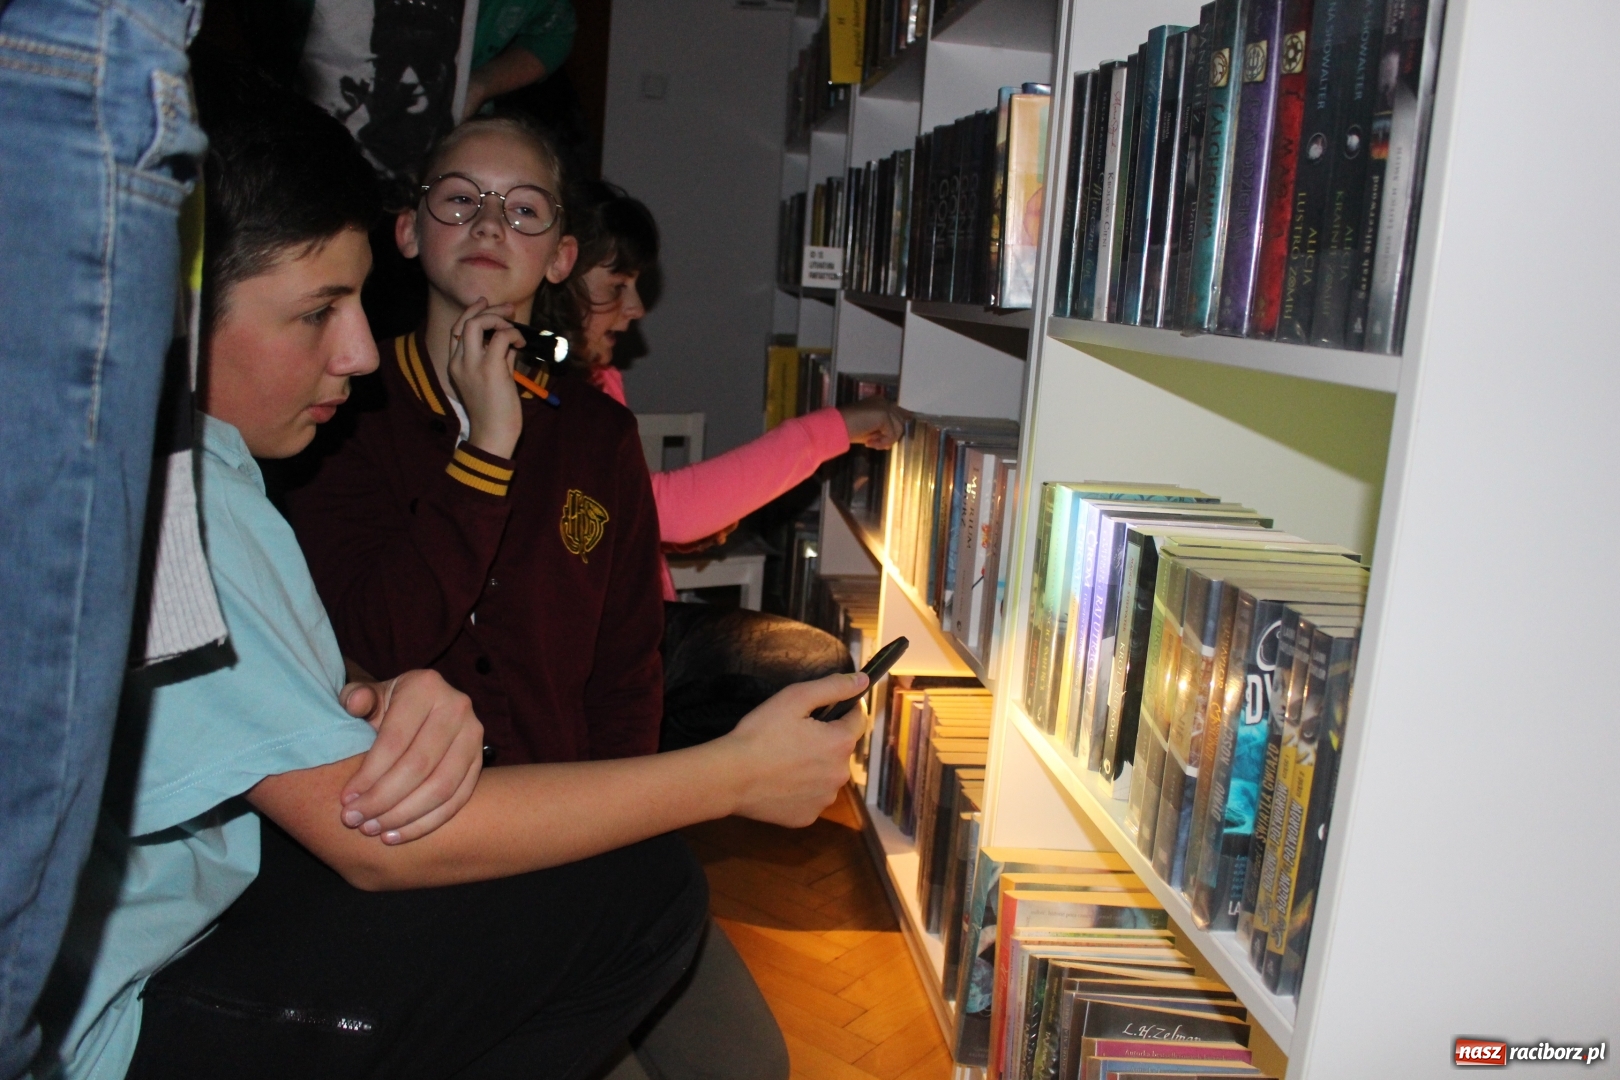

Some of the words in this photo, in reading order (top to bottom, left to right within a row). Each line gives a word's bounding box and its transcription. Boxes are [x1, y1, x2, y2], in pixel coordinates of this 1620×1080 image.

[1317, 25, 1333, 109] SHOWALTER
[1291, 192, 1307, 260] LUSTRO
[1303, 227, 1318, 286] ALICJA
[966, 467, 980, 549] IMPRIUM
[1094, 595, 1103, 619] RAJ
[1086, 621, 1101, 695] UTRACONY
[1263, 743, 1280, 791] GWIAZD
[1212, 781, 1226, 822] DYMU
